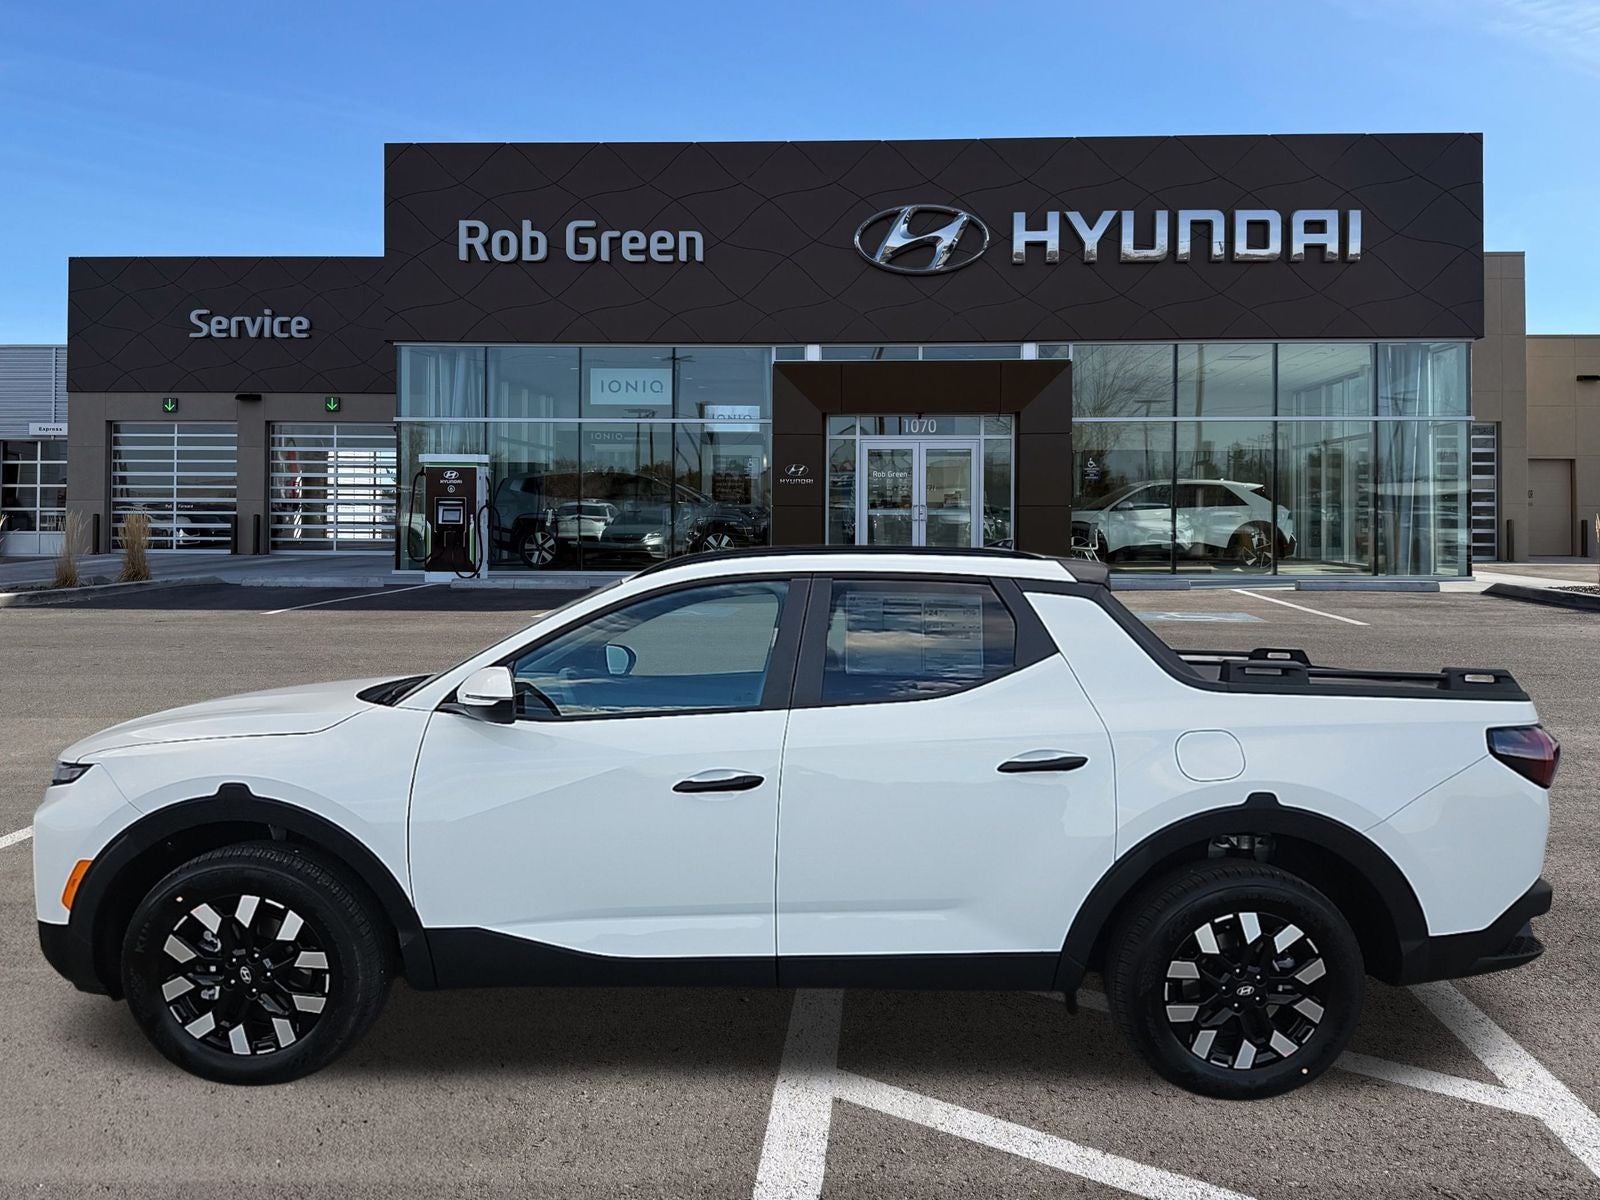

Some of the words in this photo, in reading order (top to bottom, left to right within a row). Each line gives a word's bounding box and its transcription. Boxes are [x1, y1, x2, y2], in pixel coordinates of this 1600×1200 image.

[458, 219, 548, 263] Rob
[565, 219, 705, 263] Green
[1011, 209, 1362, 264] HYUNDAI
[188, 308, 311, 339] Service
[600, 379, 664, 393] IONIQ
[903, 419, 937, 433] 1070
[591, 432, 623, 441] IONIQ
[872, 470, 886, 478] Rob
[887, 470, 908, 478] Green
